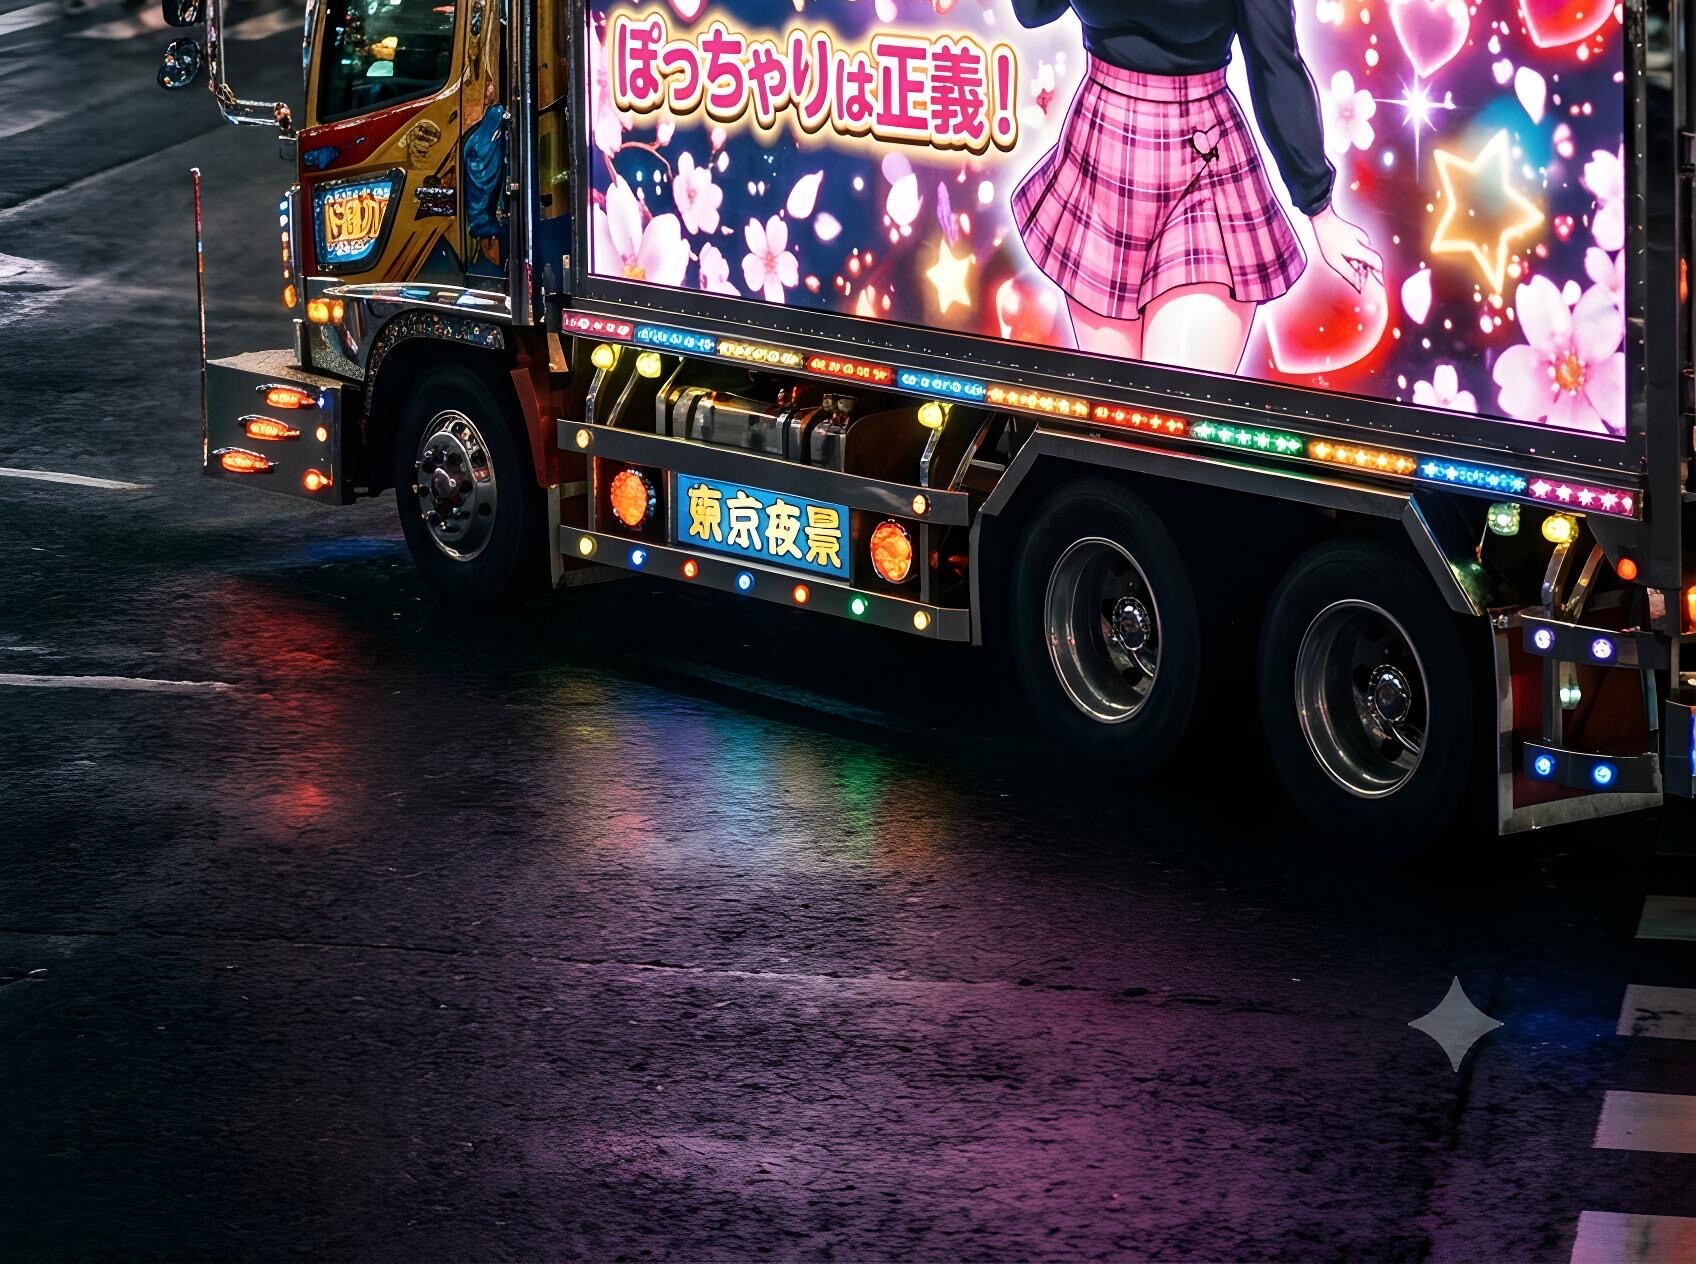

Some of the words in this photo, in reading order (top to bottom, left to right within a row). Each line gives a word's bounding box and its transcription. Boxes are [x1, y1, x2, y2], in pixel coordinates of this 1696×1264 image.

[613, 15, 1016, 147] ぽっちゃりは正義！
[687, 482, 843, 570] 東京夜景
